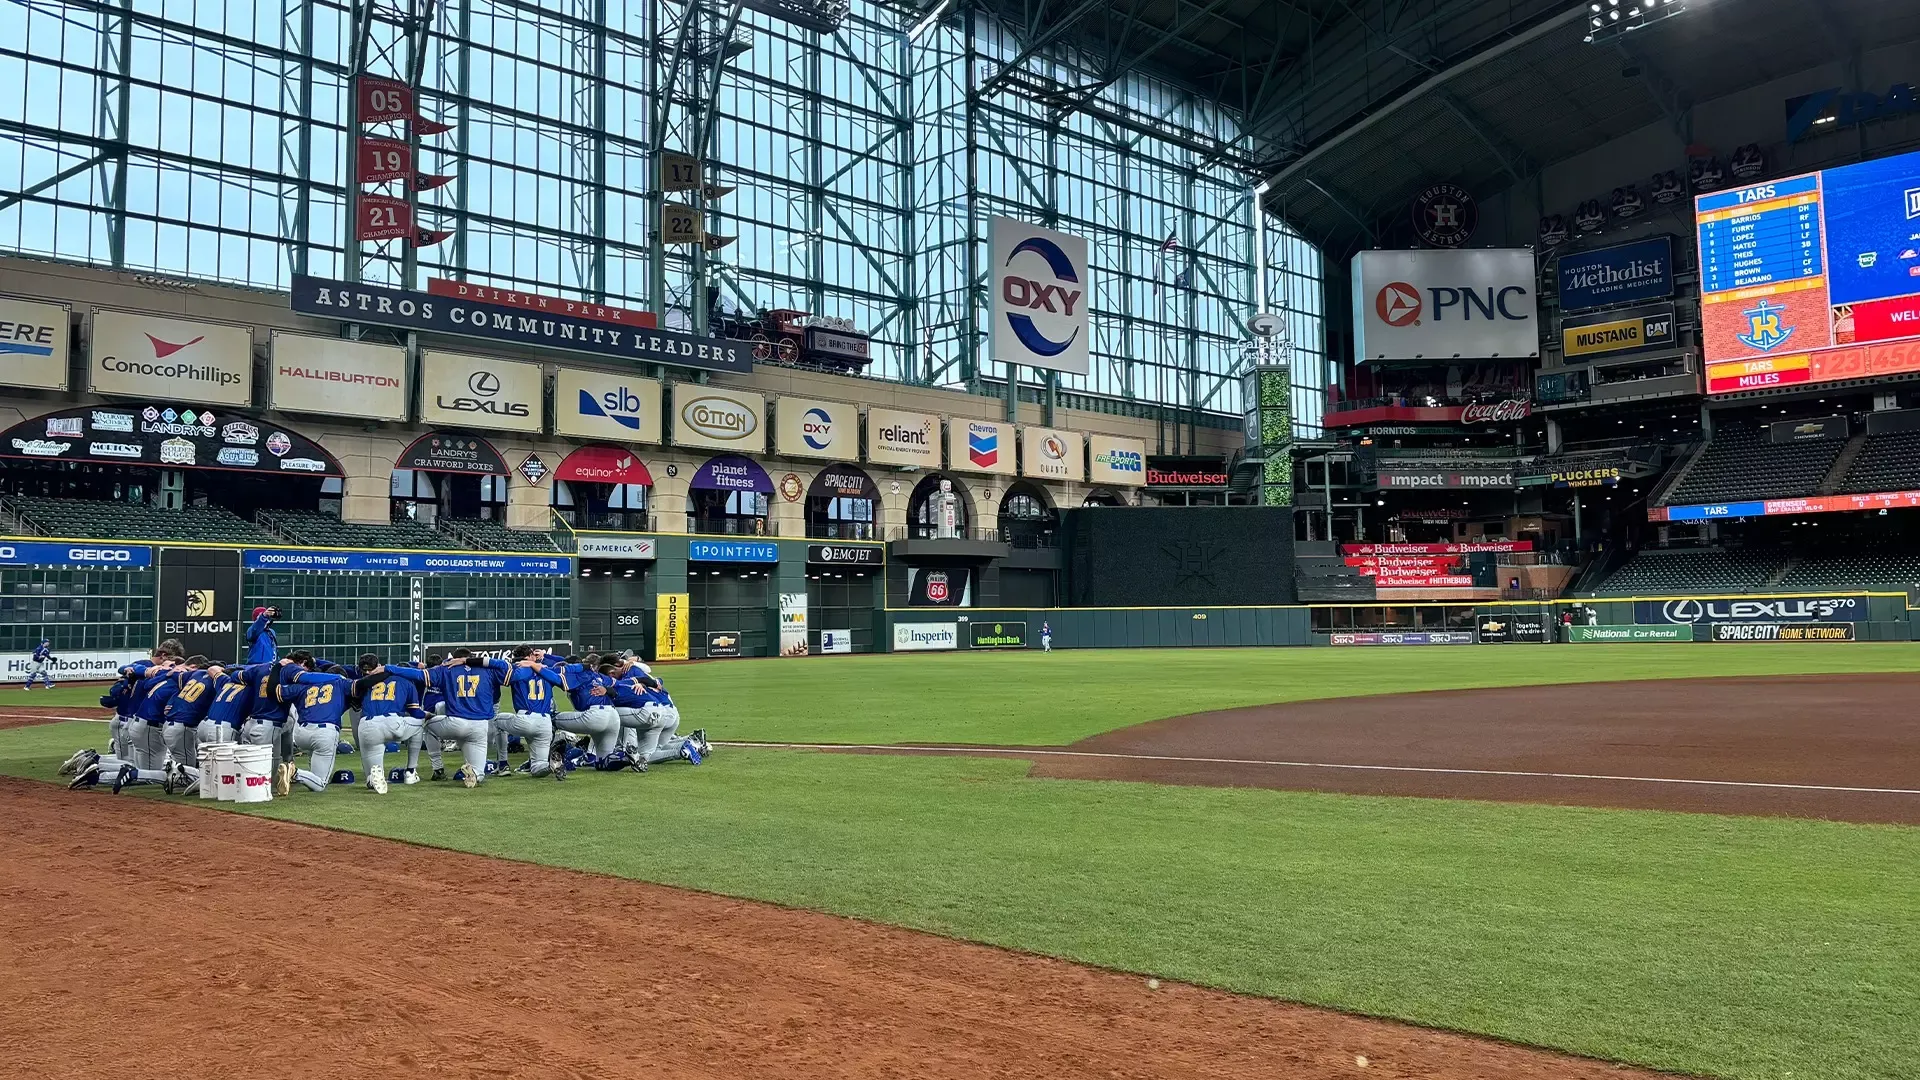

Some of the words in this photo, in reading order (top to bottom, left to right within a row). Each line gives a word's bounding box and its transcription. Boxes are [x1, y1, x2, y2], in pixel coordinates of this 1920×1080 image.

[371, 90, 402, 112] 05
[366, 111, 412, 123] CHAMPIONS
[372, 151, 401, 171] 19
[366, 171, 410, 182] CHAMPIONS
[672, 164, 694, 182] 17
[1420, 186, 1470, 204] HOUSTON
[1736, 185, 1776, 204] TARS
[369, 207, 398, 227] 21
[1731, 214, 1761, 225] BARRIOS
[672, 217, 693, 234] 22
[1732, 224, 1754, 233] FURRY
[363, 228, 405, 239] CHAMPIONS
[1423, 229, 1469, 245] ASTROS
[1732, 232, 1755, 242] LOPEZ
[1732, 241, 1757, 251] MATEO
[1733, 250, 1754, 259] THEIS
[1565, 263, 1603, 275] HOUSTON
[1734, 258, 1762, 268] HUGHES
[1566, 260, 1663, 291] Methodist
[1734, 267, 1761, 277] BROWN
[1592, 284, 1624, 295] LEADING
[1627, 277, 1663, 289] MEDICINE
[1735, 274, 1772, 286] BEJARANO
[458, 285, 548, 309] DAIKIN
[567, 302, 622, 318] PARK
[1003, 276, 1081, 316] OXY
[1427, 286, 1529, 321] PNC
[316, 287, 434, 319] ASTROS
[449, 307, 621, 346] COMMUNITY
[634, 334, 737, 363] LEADERS
[1577, 327, 1637, 347] MUSTANG
[1646, 321, 1670, 337] CAT
[102, 356, 241, 386] ConocoPhillips
[1744, 360, 1773, 373] TARS
[279, 365, 400, 387] HALLIBURTON
[1740, 373, 1780, 387] MULES
[604, 386, 640, 414] slb
[436, 395, 530, 418] LEXUS
[691, 406, 746, 431] COTTON
[141, 422, 216, 438] LANDRY'S
[803, 423, 831, 435] OXY
[969, 422, 997, 434] Chevron
[1369, 426, 1416, 435] HORNITOS
[880, 425, 926, 445] reliant
[1793, 432, 1825, 440] CHEVROLET
[160, 450, 195, 460] NUGGET
[161, 445, 195, 454] GOLDEN
[430, 448, 478, 459] LANDRY'S
[220, 451, 258, 461] AQUARIUM
[1096, 455, 1136, 465] FREEPORT
[1111, 449, 1141, 472] LNG
[280, 461, 309, 470] PLEASURE
[414, 459, 464, 470] CRAWFORD
[467, 461, 494, 471] BOXES
[712, 463, 748, 477] planet
[576, 467, 613, 478] equinor
[1148, 470, 1228, 484] Budweiser
[1551, 468, 1619, 482] PLUCKERS
[716, 474, 754, 487] fitness
[1391, 473, 1443, 488] impact
[1460, 473, 1512, 488] impact
[1568, 480, 1588, 488] WING
[1704, 506, 1729, 516] TARS
[583, 544, 594, 552] OF
[595, 544, 633, 553] AMERICA
[695, 545, 773, 557] 1POINTFIVE
[1375, 543, 1428, 554] Budweiser
[1460, 542, 1514, 553] Budweiser
[260, 555, 286, 563] GOOD
[287, 555, 312, 564] LEADS
[313, 555, 329, 564] THE
[329, 556, 349, 565] WAY
[833, 548, 871, 563] EMCJET
[1378, 557, 1434, 566] Budweiser
[425, 559, 449, 567] GOOD
[1380, 567, 1436, 577] Budweiser
[1387, 577, 1426, 585] Budweiser
[1429, 576, 1471, 585] #HITTHEBUDS
[931, 584, 944, 595] 66
[1707, 599, 1832, 618] LEXUS
[1829, 598, 1856, 609] 370
[413, 580, 421, 662] AMERICAN
[617, 615, 639, 625] 366
[669, 596, 677, 652] DOGGETT
[782, 613, 804, 623] WM
[165, 621, 233, 633] BETMGM
[911, 629, 954, 645] Insperity
[1592, 629, 1631, 640] National
[1634, 630, 1649, 638] Car
[1649, 630, 1677, 638] Rental
[1779, 627, 1804, 640] HOME
[1804, 627, 1847, 640] NETWORK
[977, 636, 1006, 646] Huntington
[1006, 635, 1020, 644] Bank
[178, 678, 206, 704] 20
[371, 681, 397, 701] 21
[456, 674, 480, 697] 17
[528, 679, 545, 700] 11
[215, 682, 247, 703] 77
[304, 684, 335, 709] 23
[487, 763, 494, 771] R
[340, 772, 349, 780] R
[392, 771, 399, 780] R
